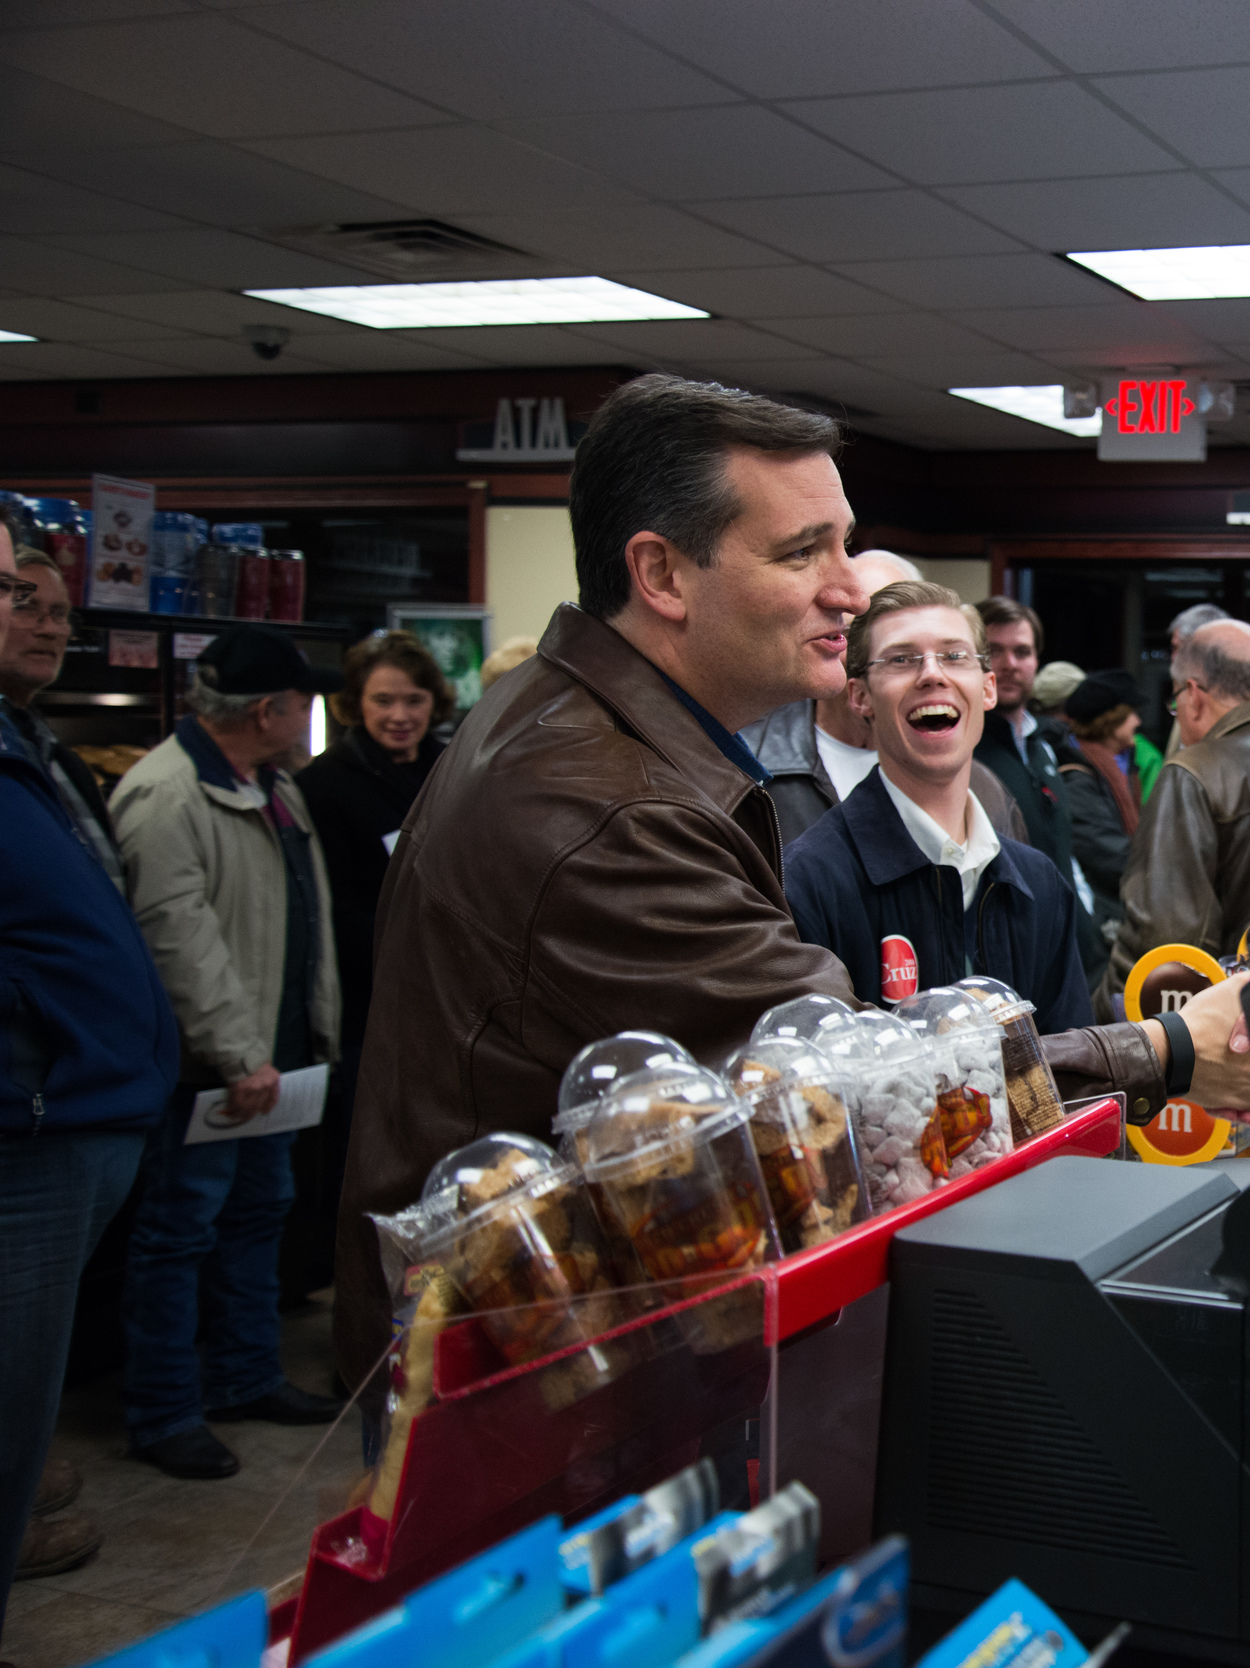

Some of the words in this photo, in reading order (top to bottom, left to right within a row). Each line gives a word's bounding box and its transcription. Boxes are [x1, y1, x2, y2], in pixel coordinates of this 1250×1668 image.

[494, 397, 569, 450] ATM
[1118, 380, 1187, 434] EXIT
[1160, 989, 1194, 1012] m
[1158, 1102, 1193, 1133] m
